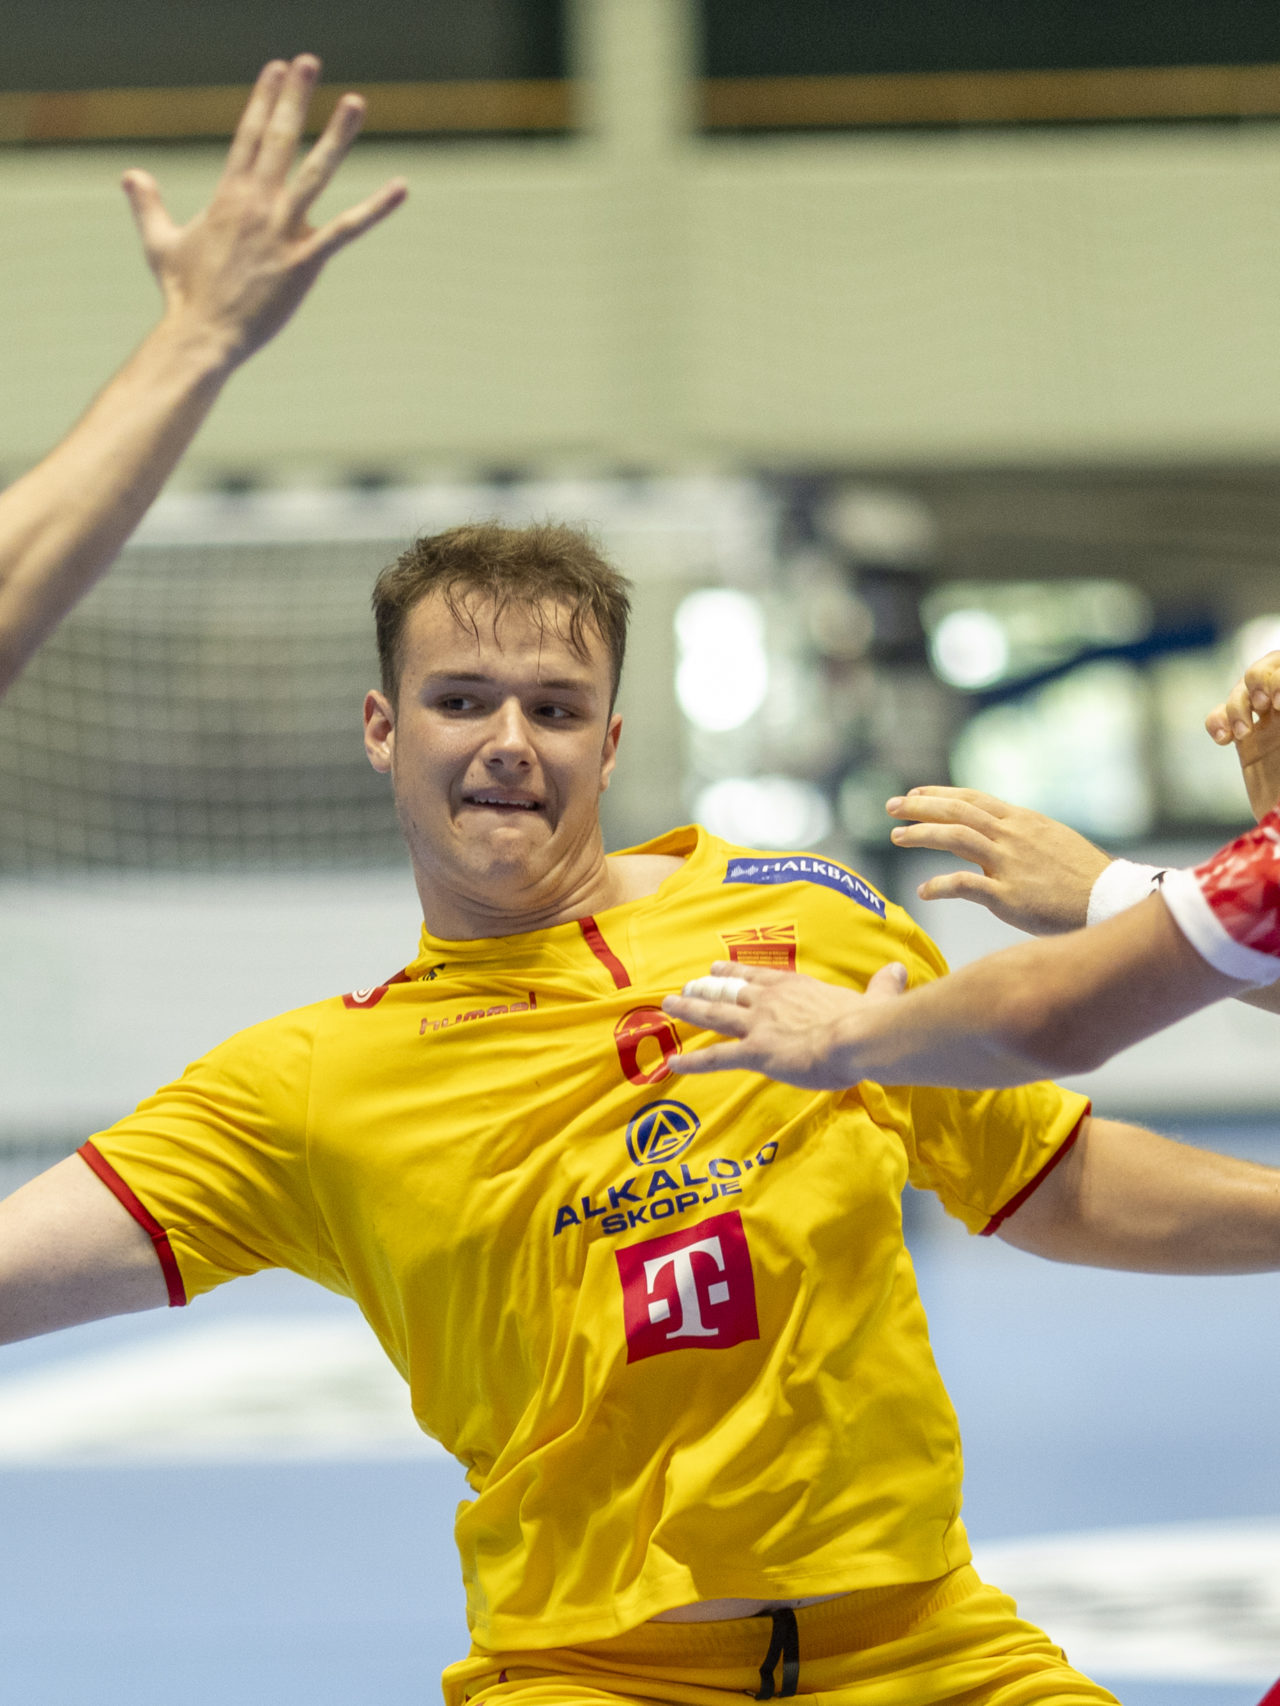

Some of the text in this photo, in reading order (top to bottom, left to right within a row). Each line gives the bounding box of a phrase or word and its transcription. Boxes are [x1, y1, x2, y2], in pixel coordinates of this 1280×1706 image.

[762, 860, 881, 909] HALKBANK
[601, 1181, 743, 1236] SKOPJE
[643, 1235, 730, 1339] T
